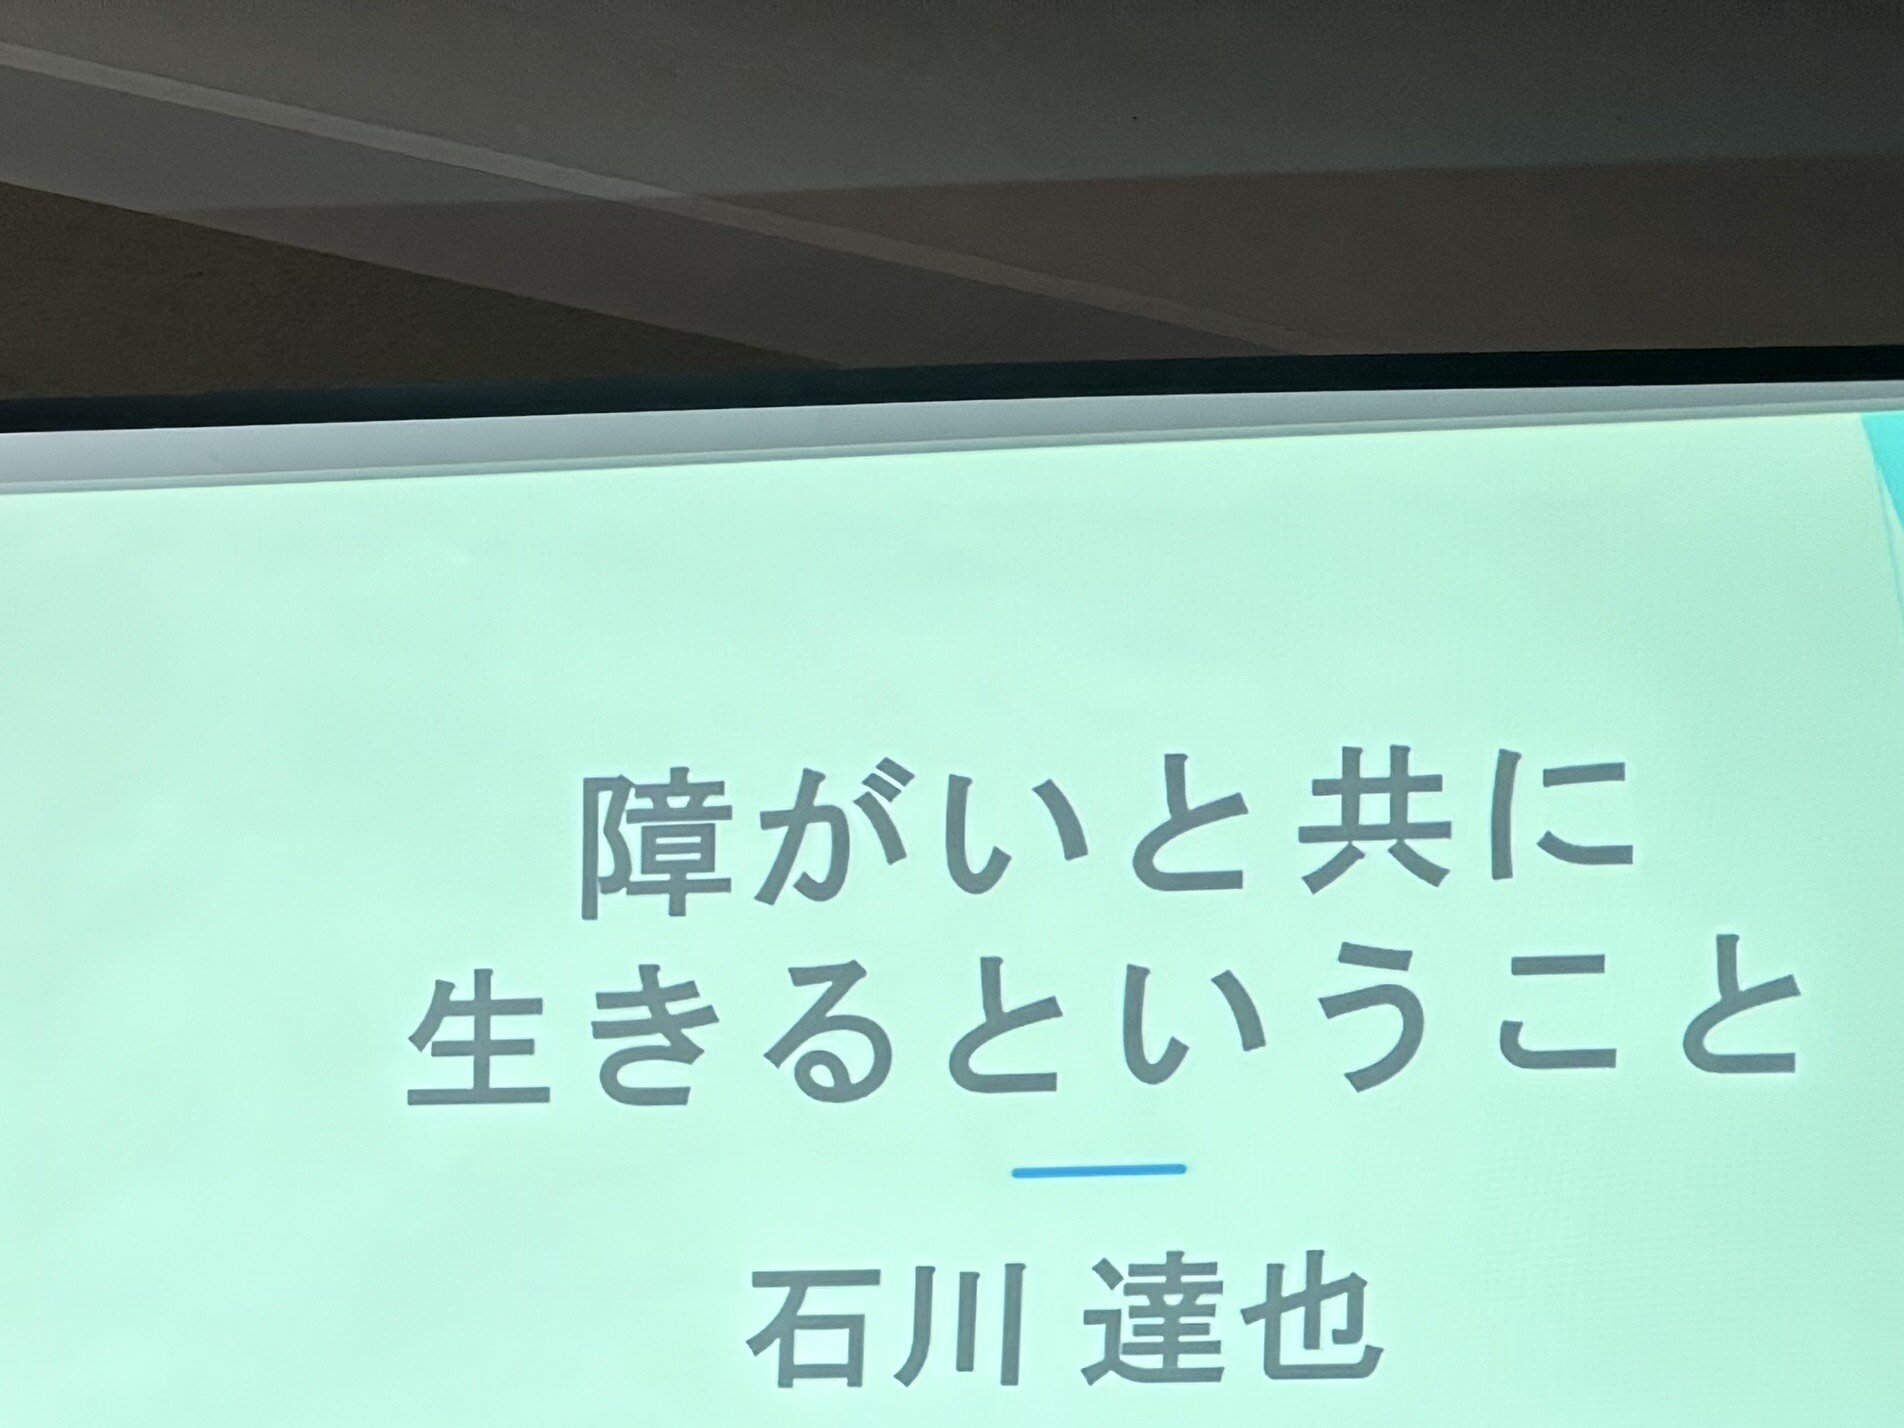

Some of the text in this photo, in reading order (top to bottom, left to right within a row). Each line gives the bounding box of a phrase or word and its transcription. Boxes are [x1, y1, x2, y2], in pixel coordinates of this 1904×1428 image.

[582, 745, 1633, 920] 障がいと共に
[408, 935, 1799, 1106] 生きるということ
[748, 1250, 1382, 1387] 石川 達也
